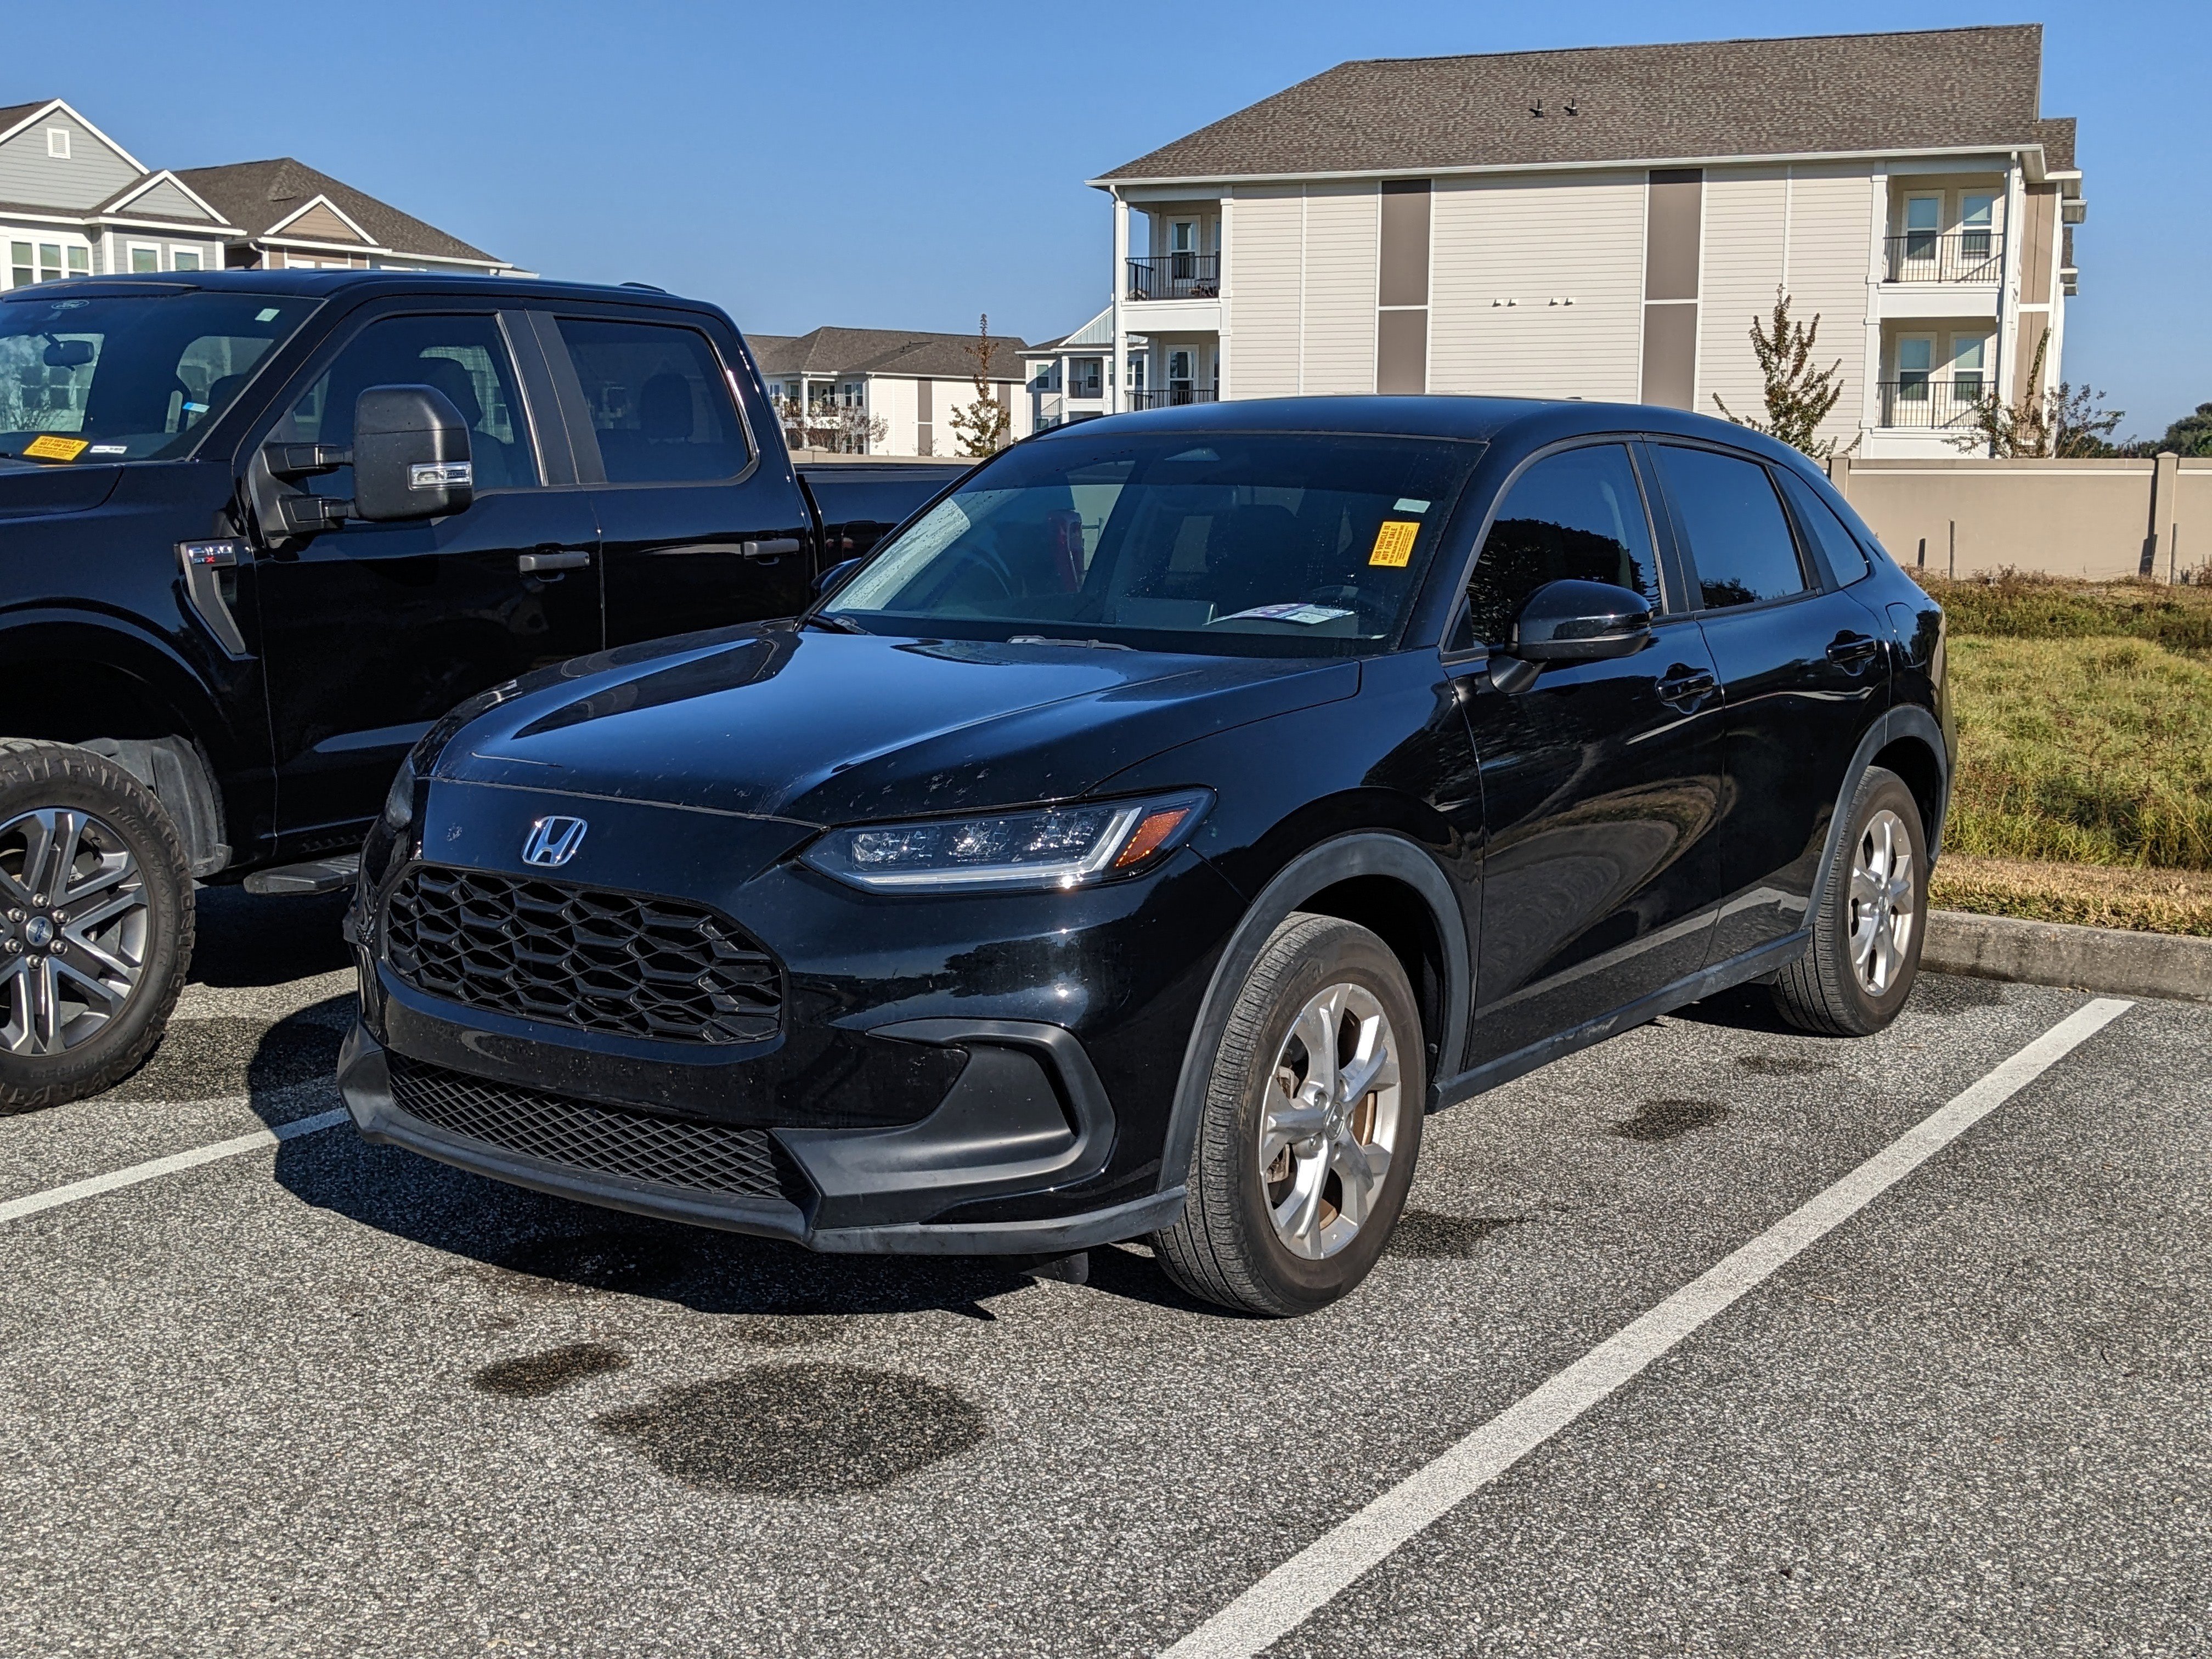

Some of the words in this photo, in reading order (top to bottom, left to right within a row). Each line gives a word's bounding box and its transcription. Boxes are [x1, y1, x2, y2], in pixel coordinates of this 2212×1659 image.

[1376, 531, 1389, 550] VEHICLE
[1385, 540, 1393, 549] FOR
[1389, 528, 1397, 539] SALE
[1373, 551, 1381, 562] THIS
